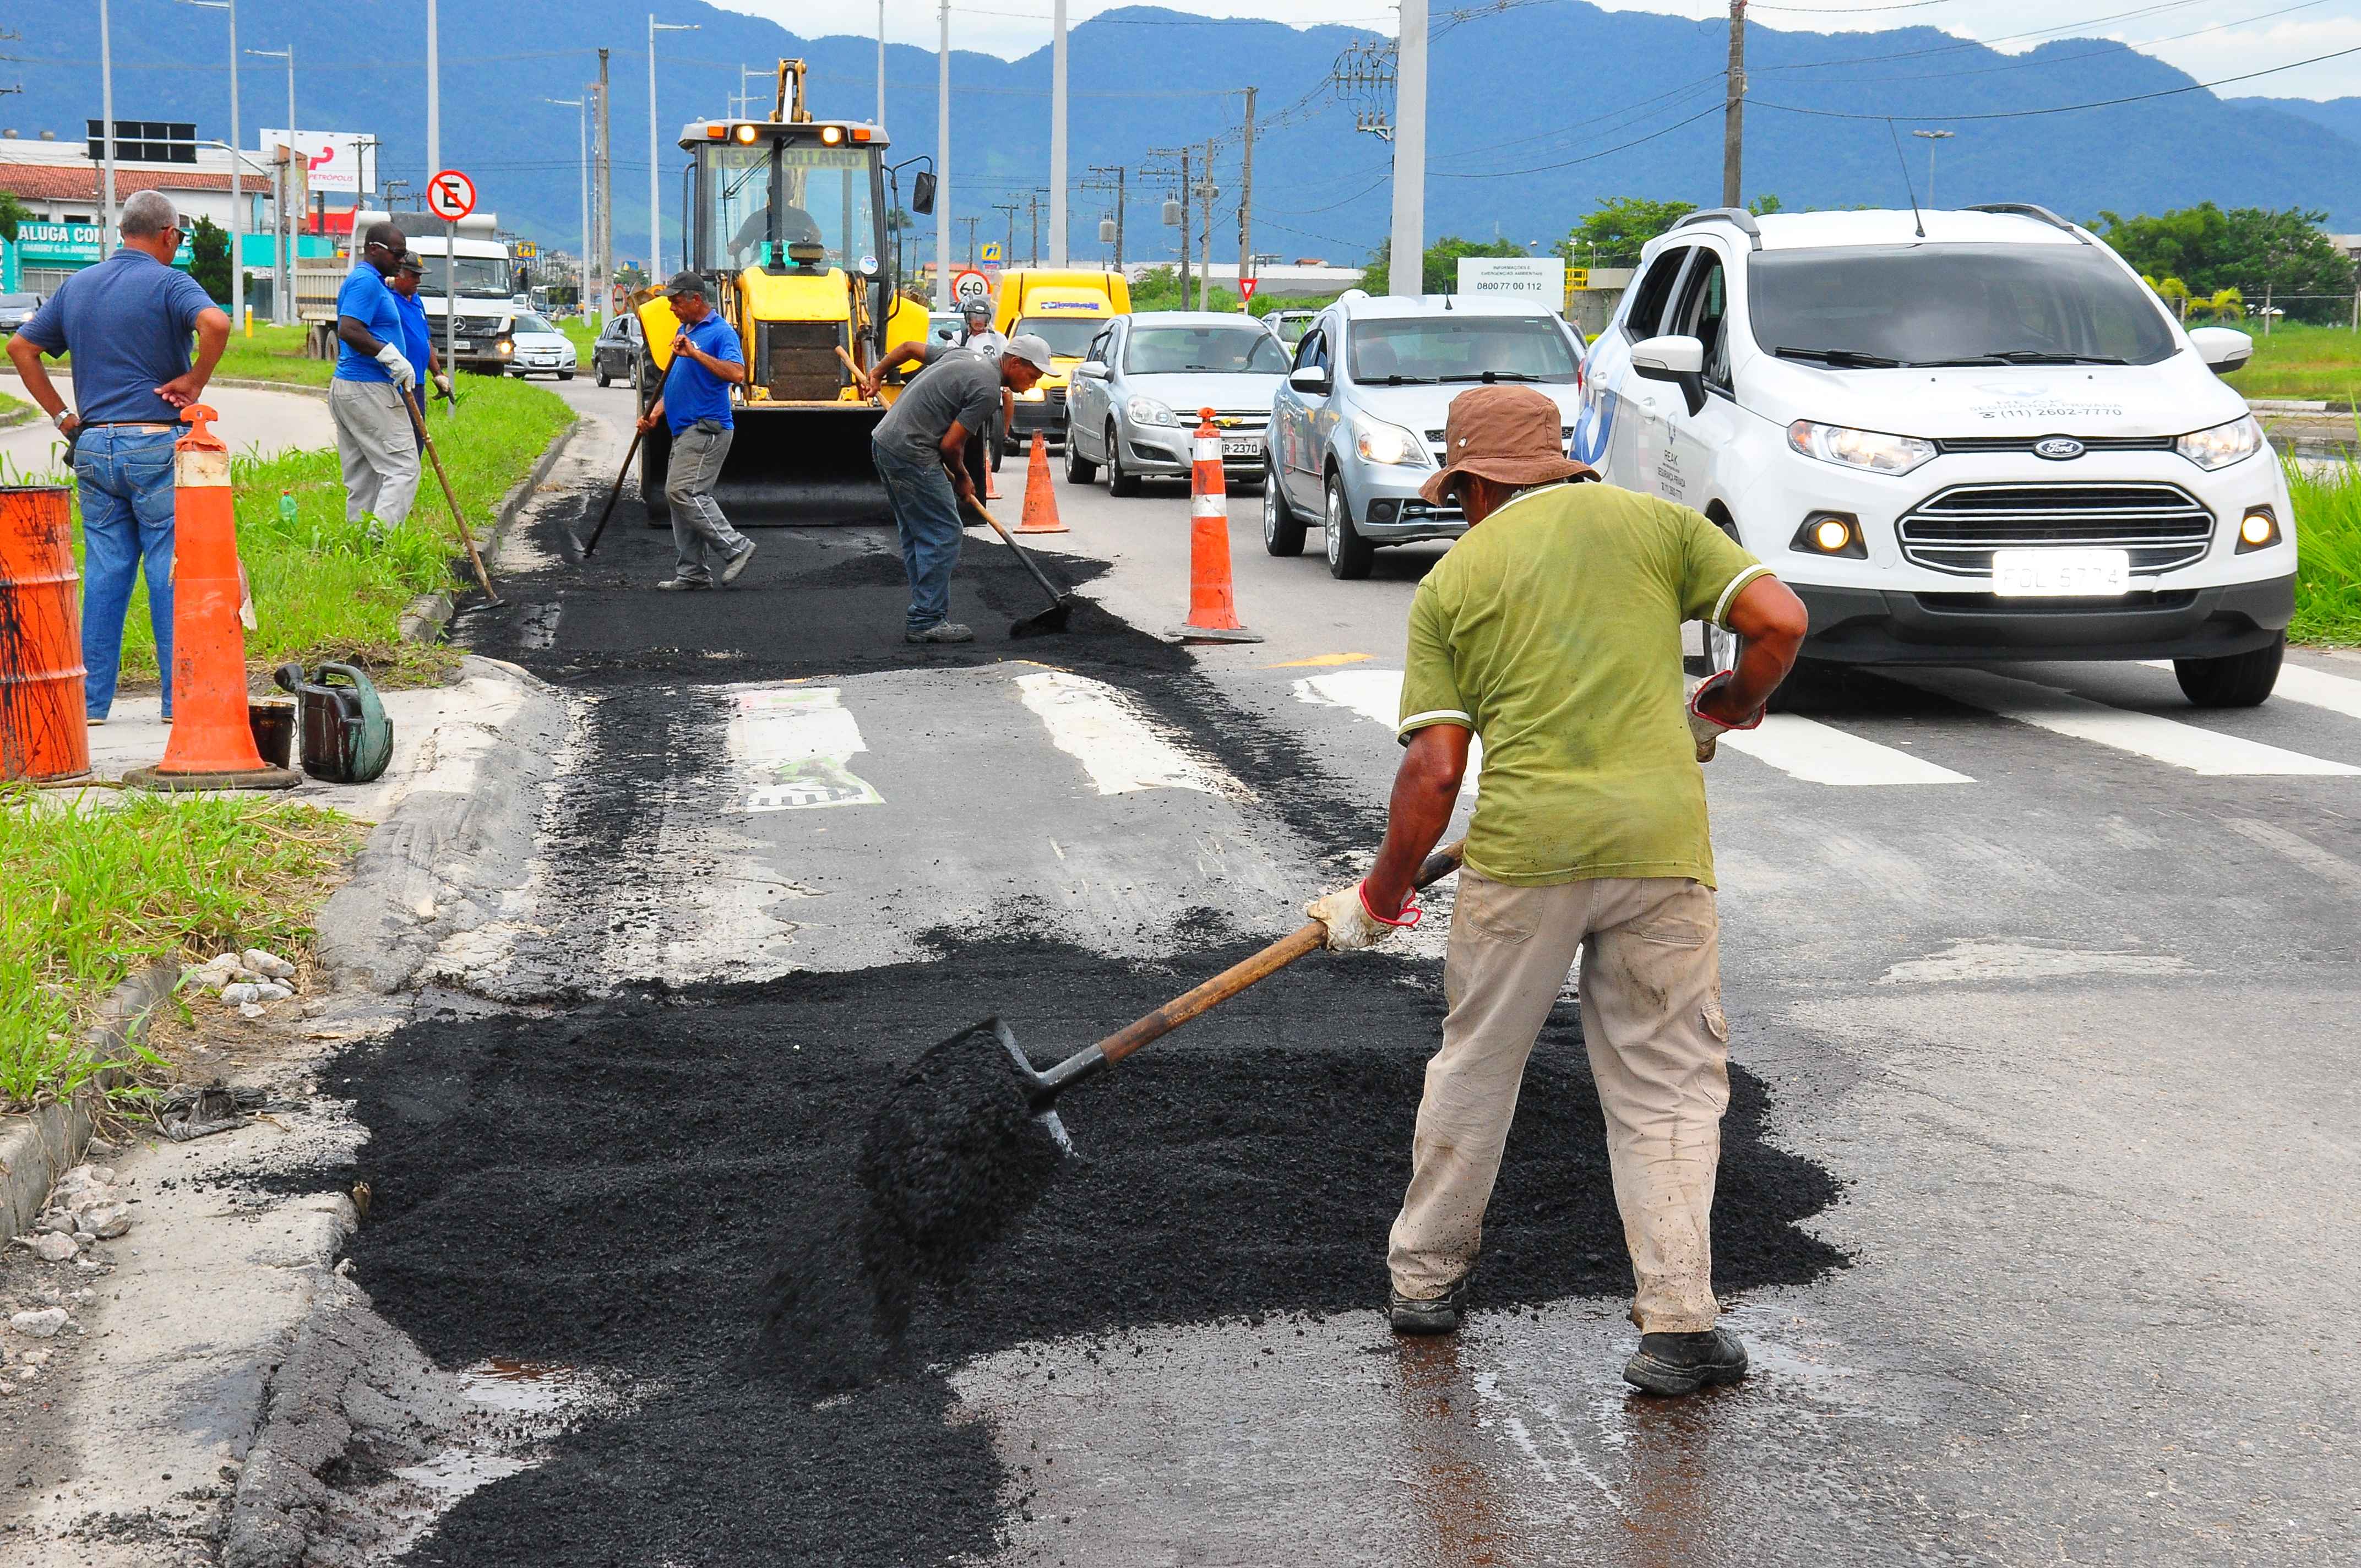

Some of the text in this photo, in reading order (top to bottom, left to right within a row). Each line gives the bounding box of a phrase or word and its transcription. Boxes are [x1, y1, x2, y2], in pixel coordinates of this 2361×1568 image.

[716, 149, 862, 165] NEW OLLAND
[443, 182, 460, 208] E
[18, 226, 69, 242] ALUGA
[960, 281, 983, 295] 60
[2001, 410, 2032, 418] (11)
[2047, 441, 2074, 453] Ford
